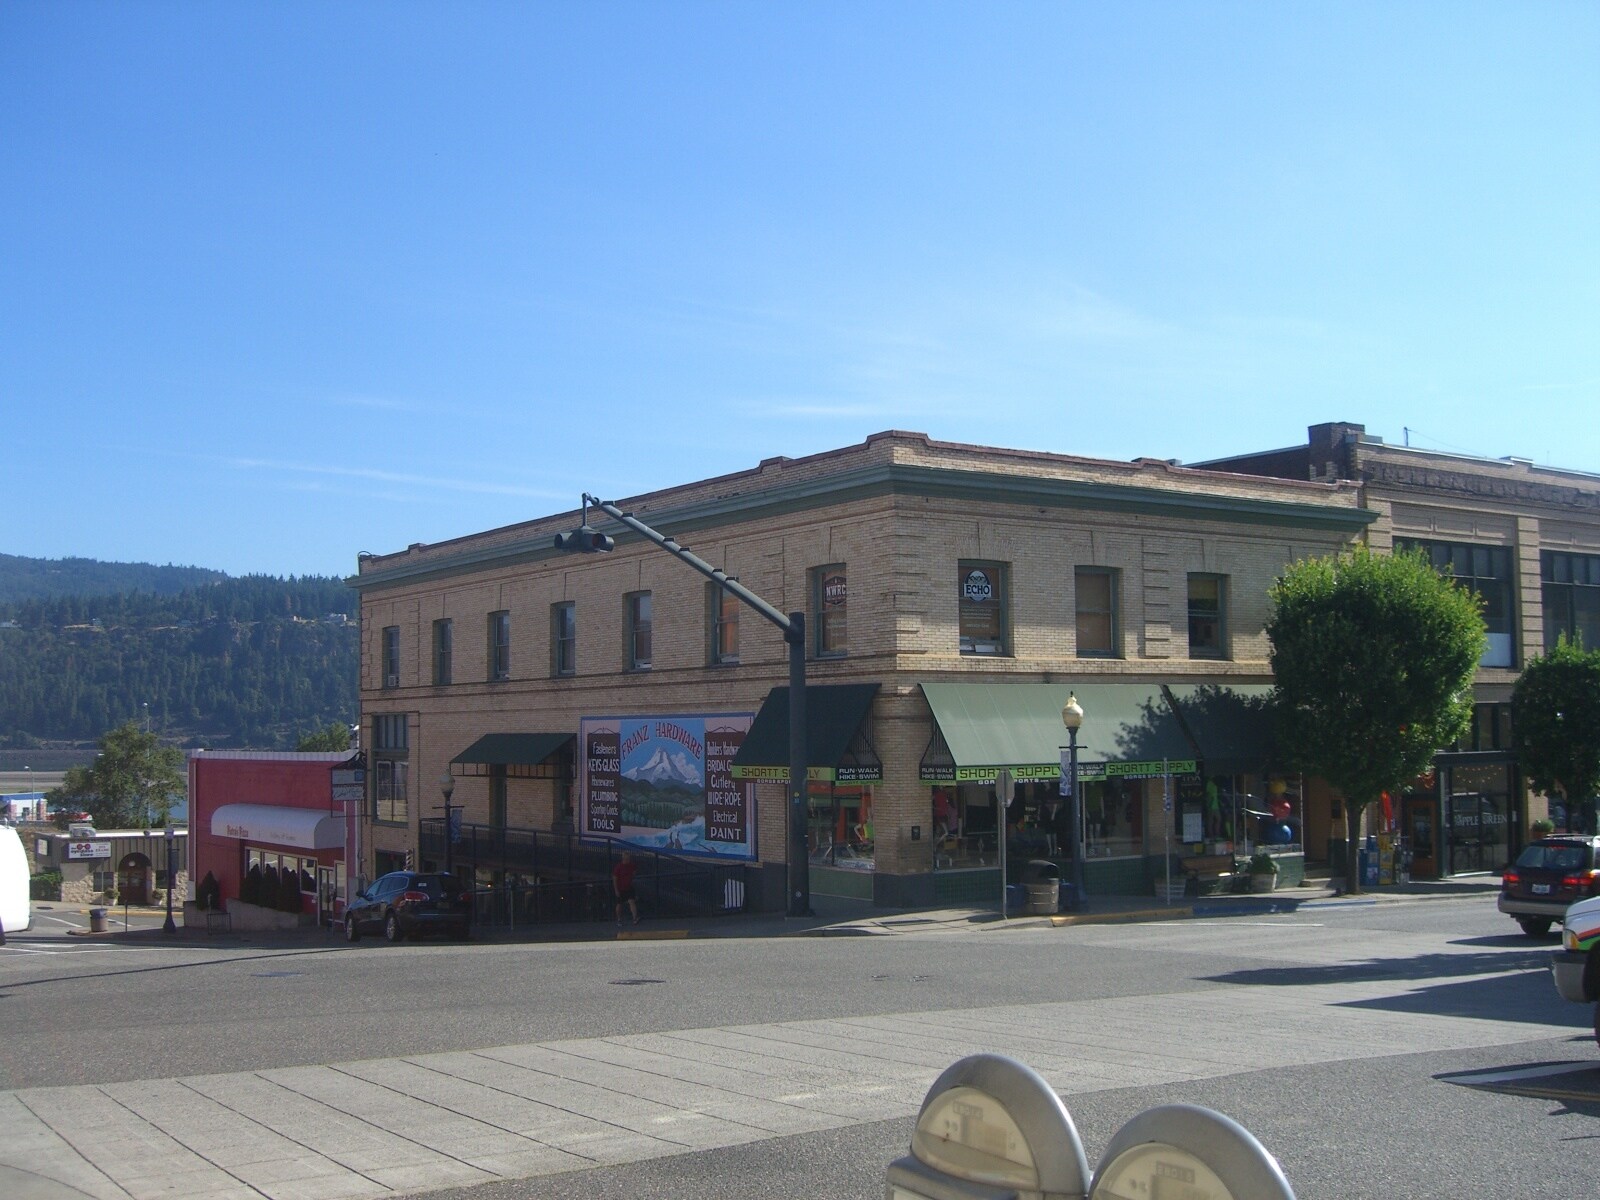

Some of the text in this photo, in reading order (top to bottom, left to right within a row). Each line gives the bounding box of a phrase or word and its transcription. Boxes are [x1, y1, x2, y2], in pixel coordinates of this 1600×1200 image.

[966, 584, 990, 595] ECHO
[621, 721, 703, 760] FRANZ HARDWARE
[741, 767, 778, 777] SHORTT
[1108, 763, 1153, 774] SHORTT
[711, 774, 736, 791] Cutlery
[713, 810, 738, 824] Electrical
[592, 818, 615, 830] TOOLS
[710, 826, 742, 841] PAINT
